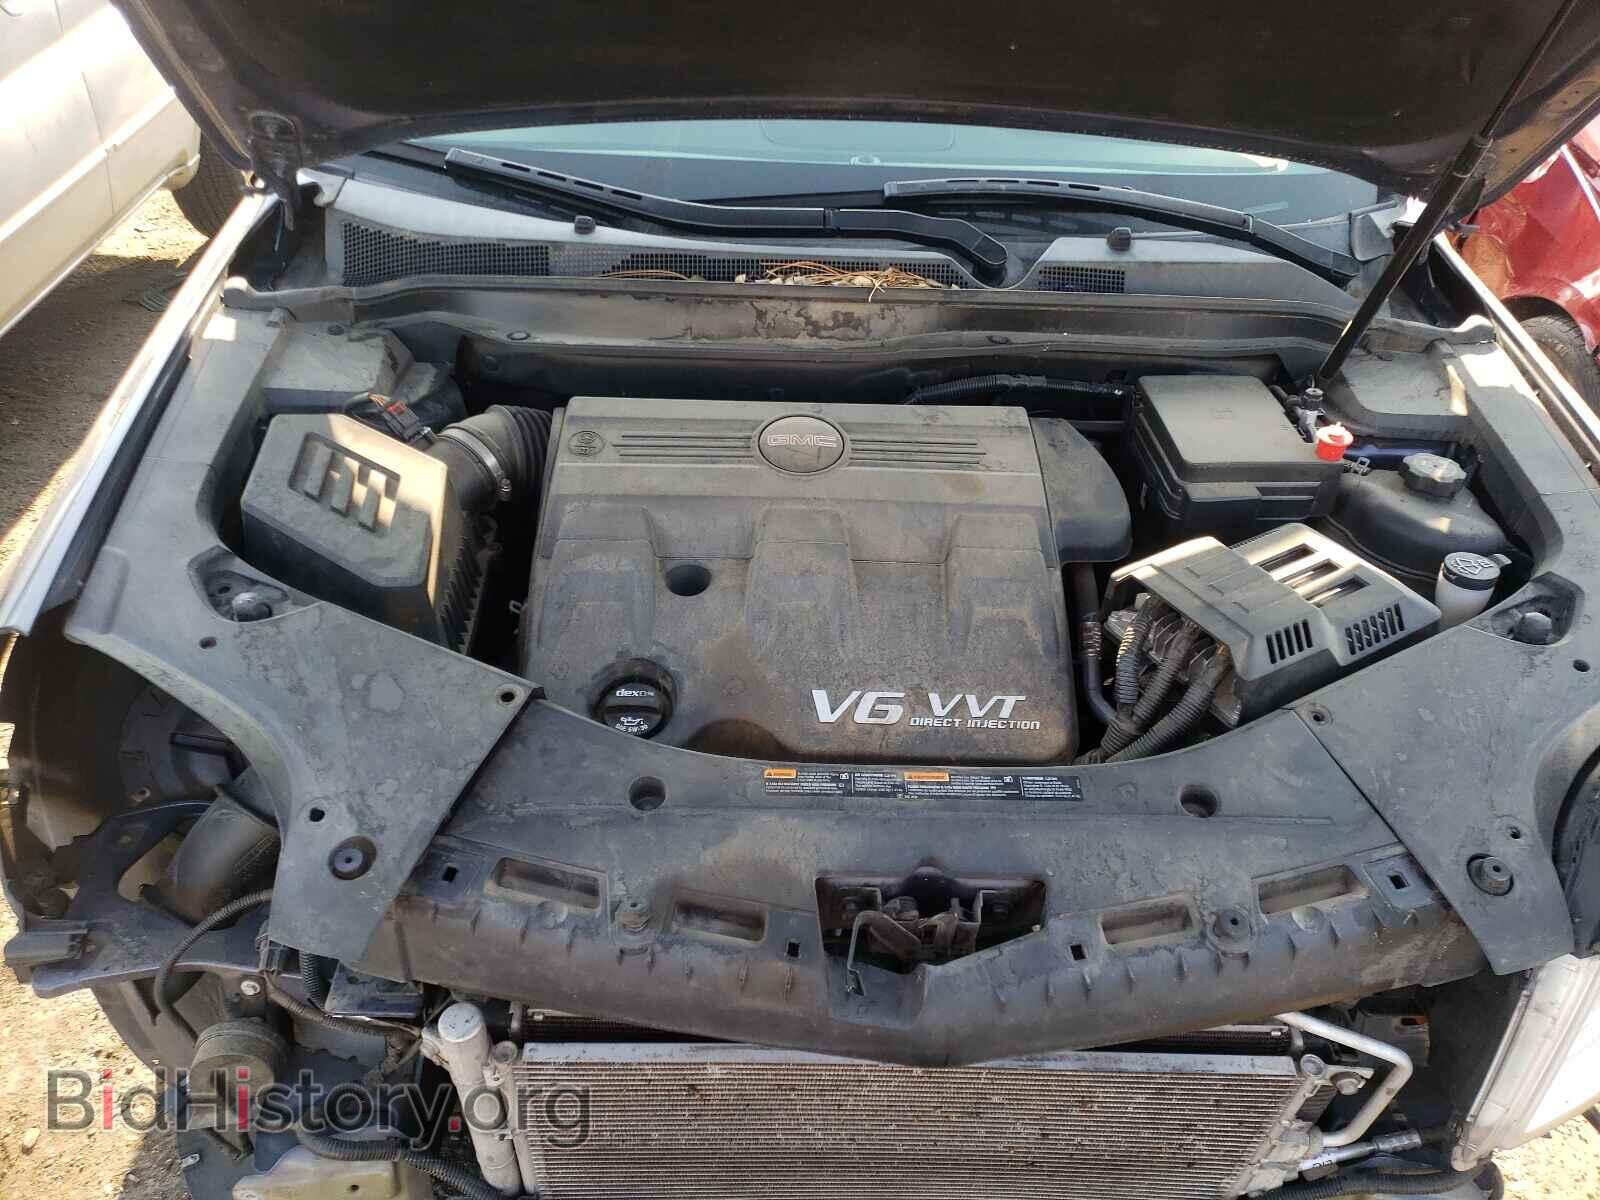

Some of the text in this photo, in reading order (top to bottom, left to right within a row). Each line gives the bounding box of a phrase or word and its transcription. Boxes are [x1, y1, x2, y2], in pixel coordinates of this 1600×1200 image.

[767, 433, 837, 448] GMC
[811, 689, 1026, 725] V6 VVT
[909, 717, 1041, 730] DIRECT INJECTION
